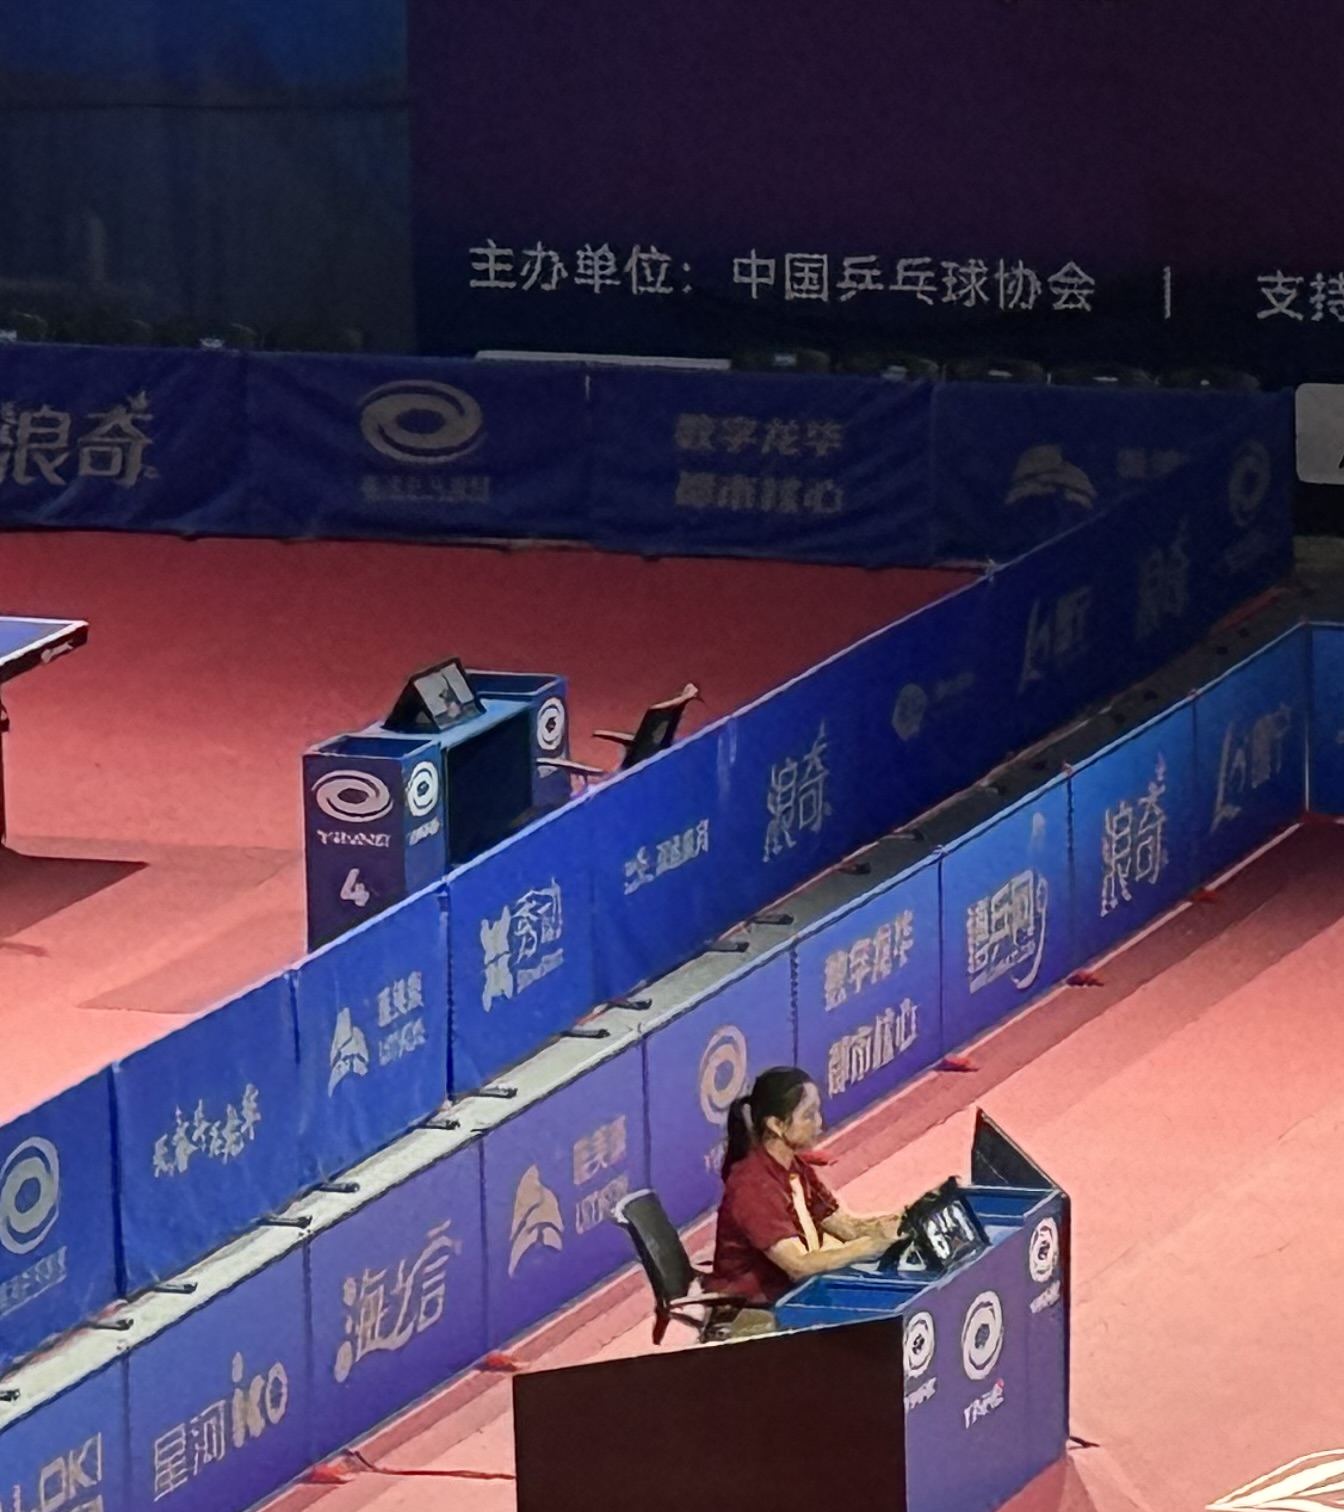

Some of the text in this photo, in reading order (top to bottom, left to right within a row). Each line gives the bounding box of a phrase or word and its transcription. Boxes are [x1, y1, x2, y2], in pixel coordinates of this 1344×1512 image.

[469, 239, 693, 295] 主办单位：
[732, 248, 1096, 313] 中国乒乓球协会
[340, 867, 371, 907] 4
